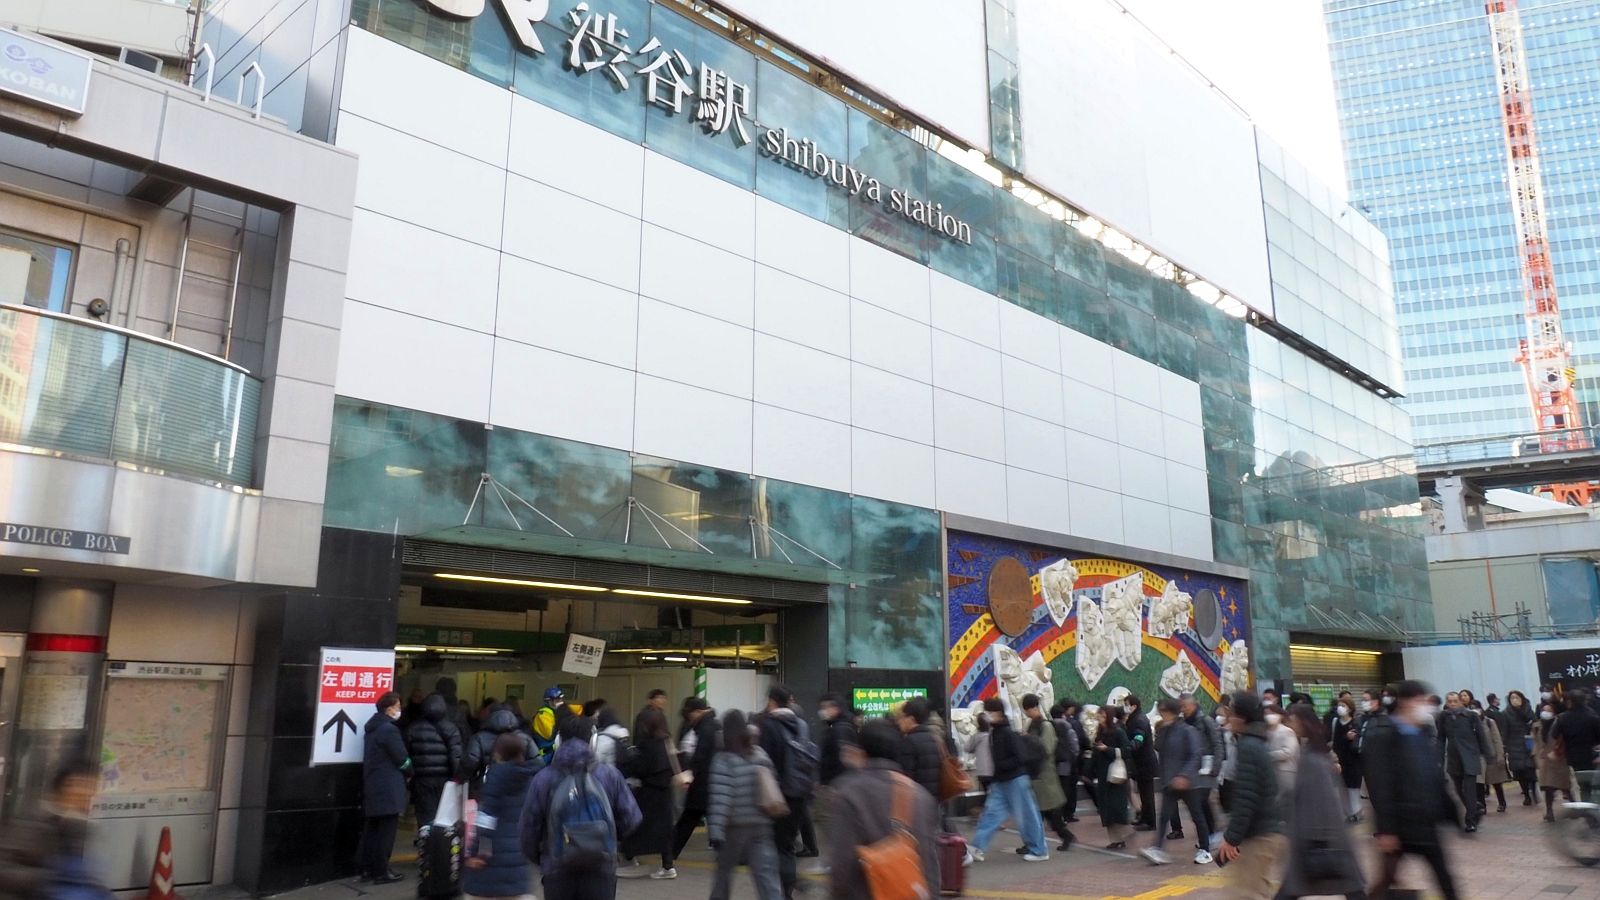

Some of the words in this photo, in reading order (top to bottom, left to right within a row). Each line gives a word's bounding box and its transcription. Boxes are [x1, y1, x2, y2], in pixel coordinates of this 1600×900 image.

[569, 2, 752, 147] 渋谷駅
[765, 127, 882, 203] shibuya
[889, 187, 972, 246] station
[3, 524, 73, 547] POLICE
[84, 533, 119, 552] BOX
[571, 641, 603, 657] 左側通行
[323, 671, 393, 688] 左側通行
[336, 690, 357, 698] KEEP
[357, 691, 377, 699] LEFT
